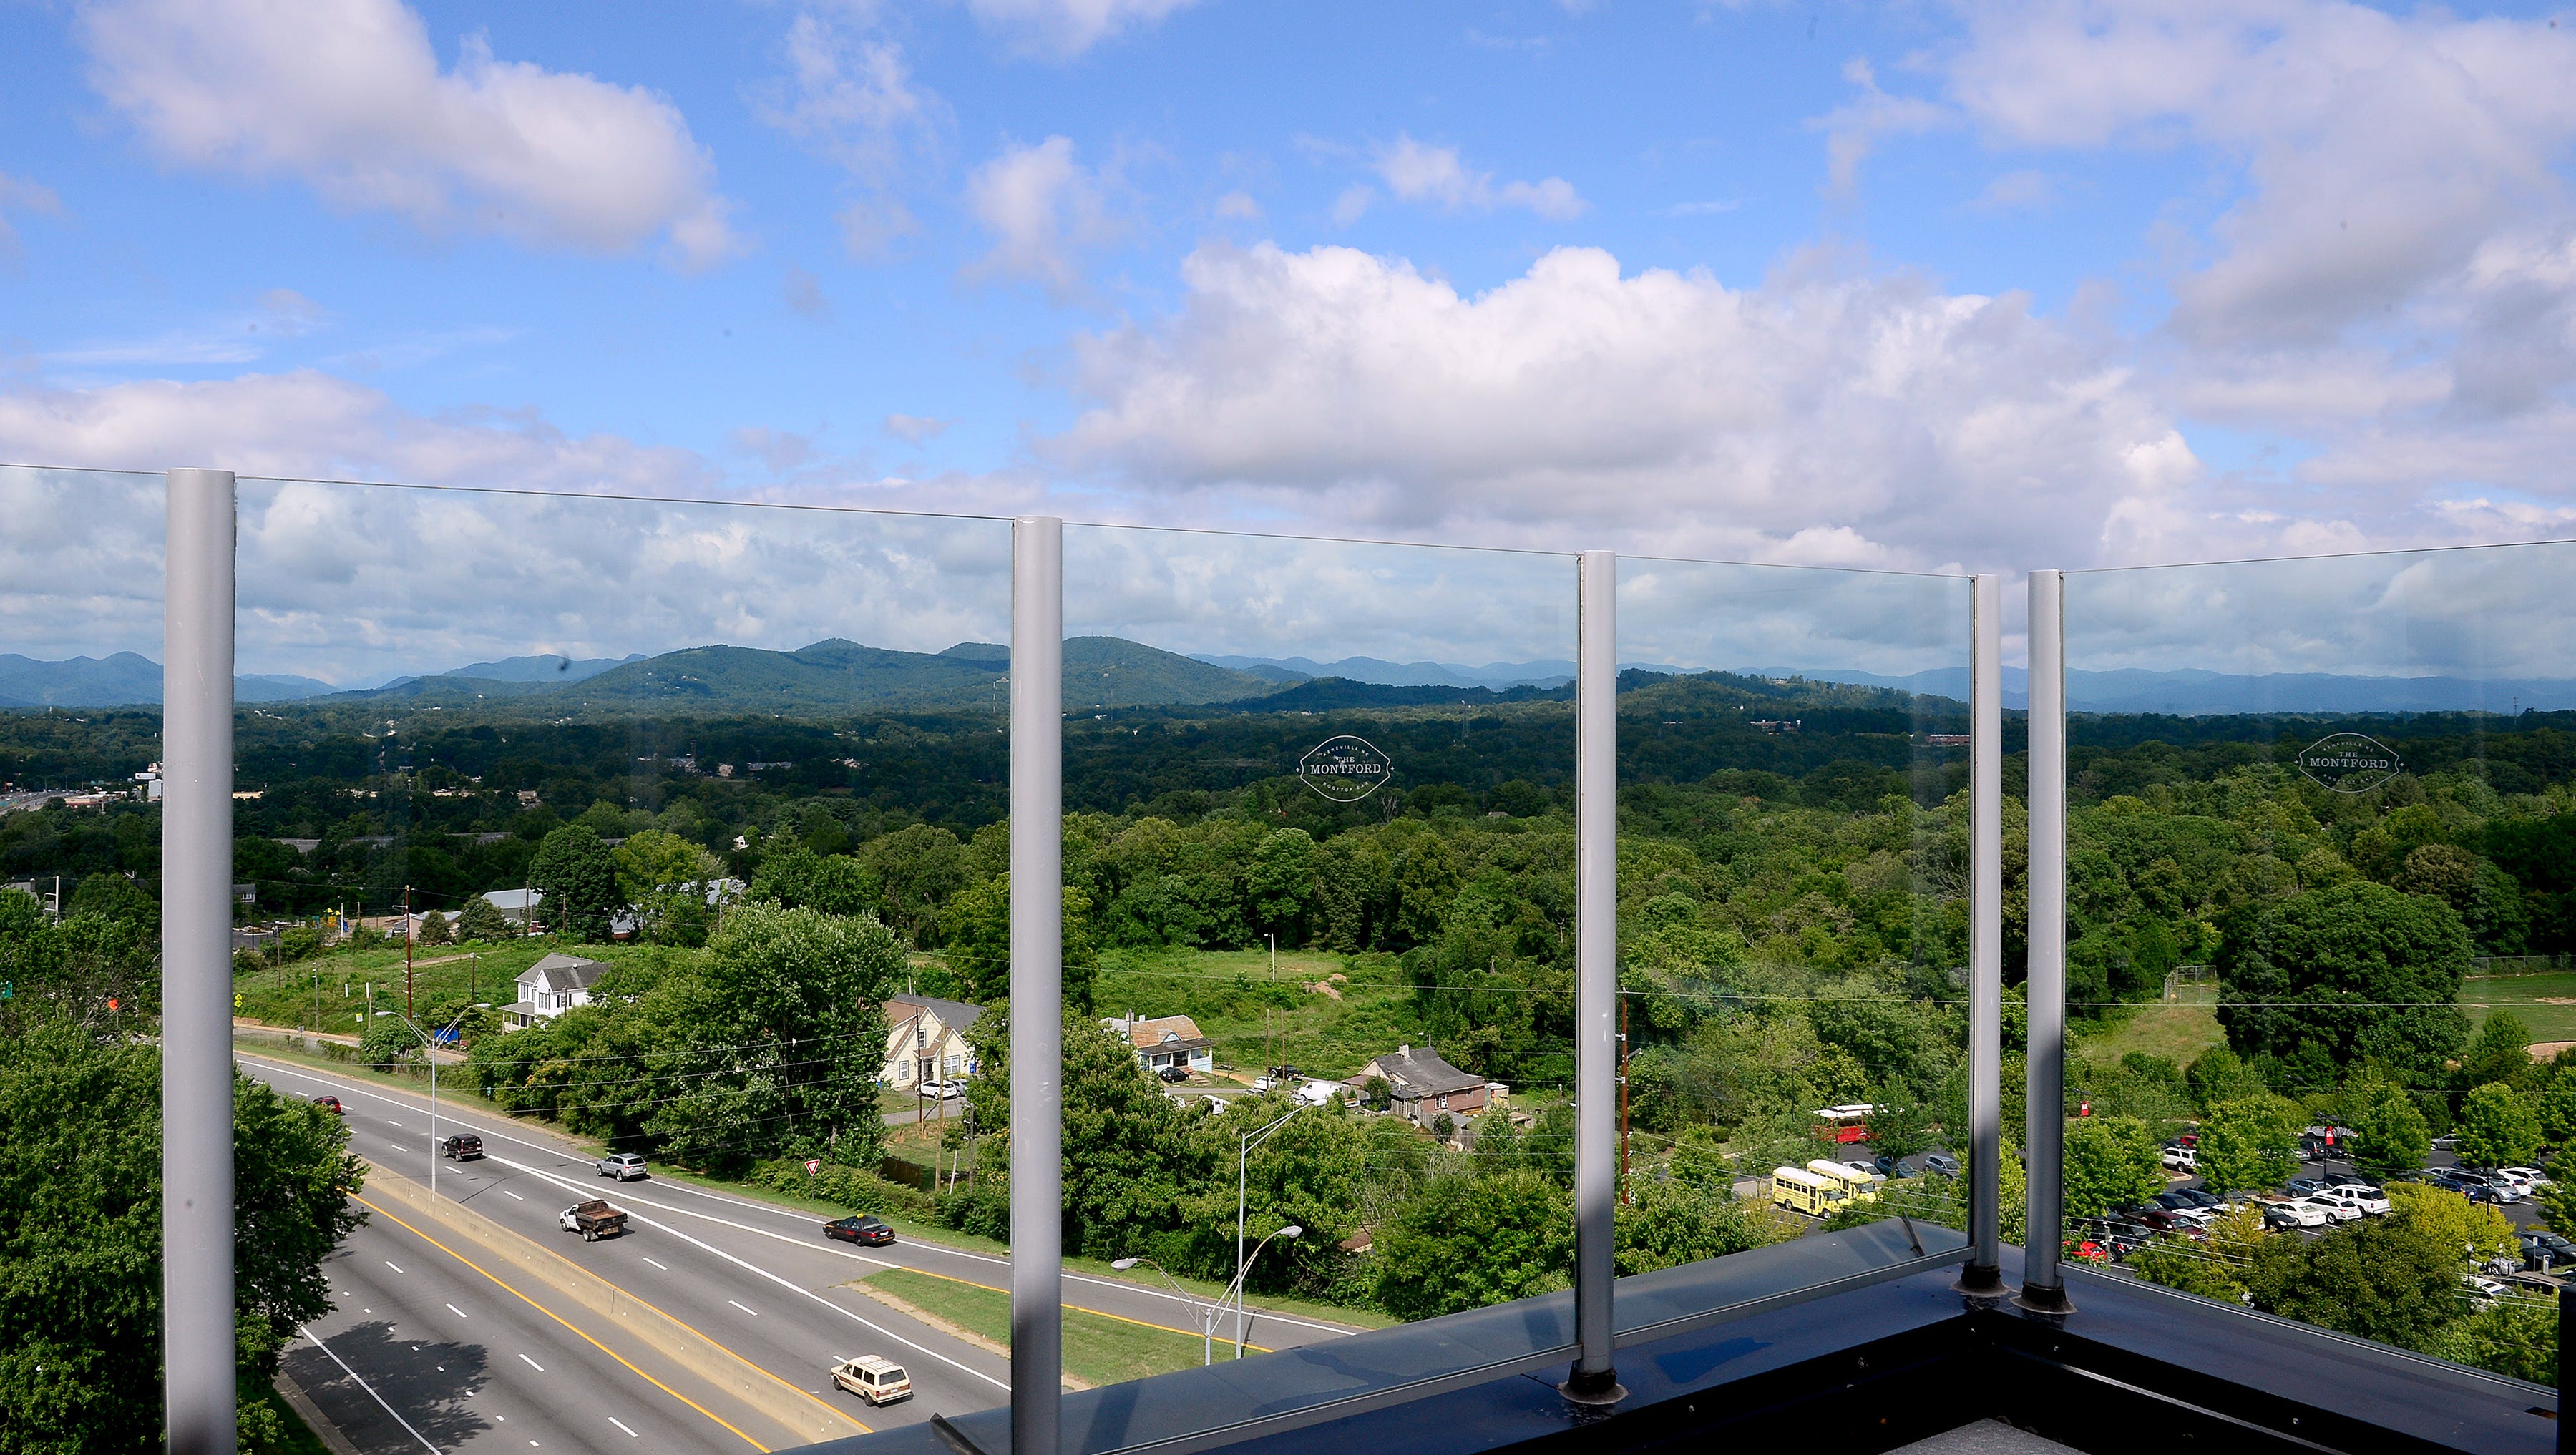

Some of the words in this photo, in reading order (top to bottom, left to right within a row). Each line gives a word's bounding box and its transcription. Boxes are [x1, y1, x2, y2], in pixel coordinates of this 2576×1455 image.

[1322, 745, 1358, 757] ASHEVILLE
[2310, 758, 2389, 768] MONTFORD
[1310, 764, 1381, 775] MONTFORD
[1322, 781, 1352, 792] ROOFTOP
